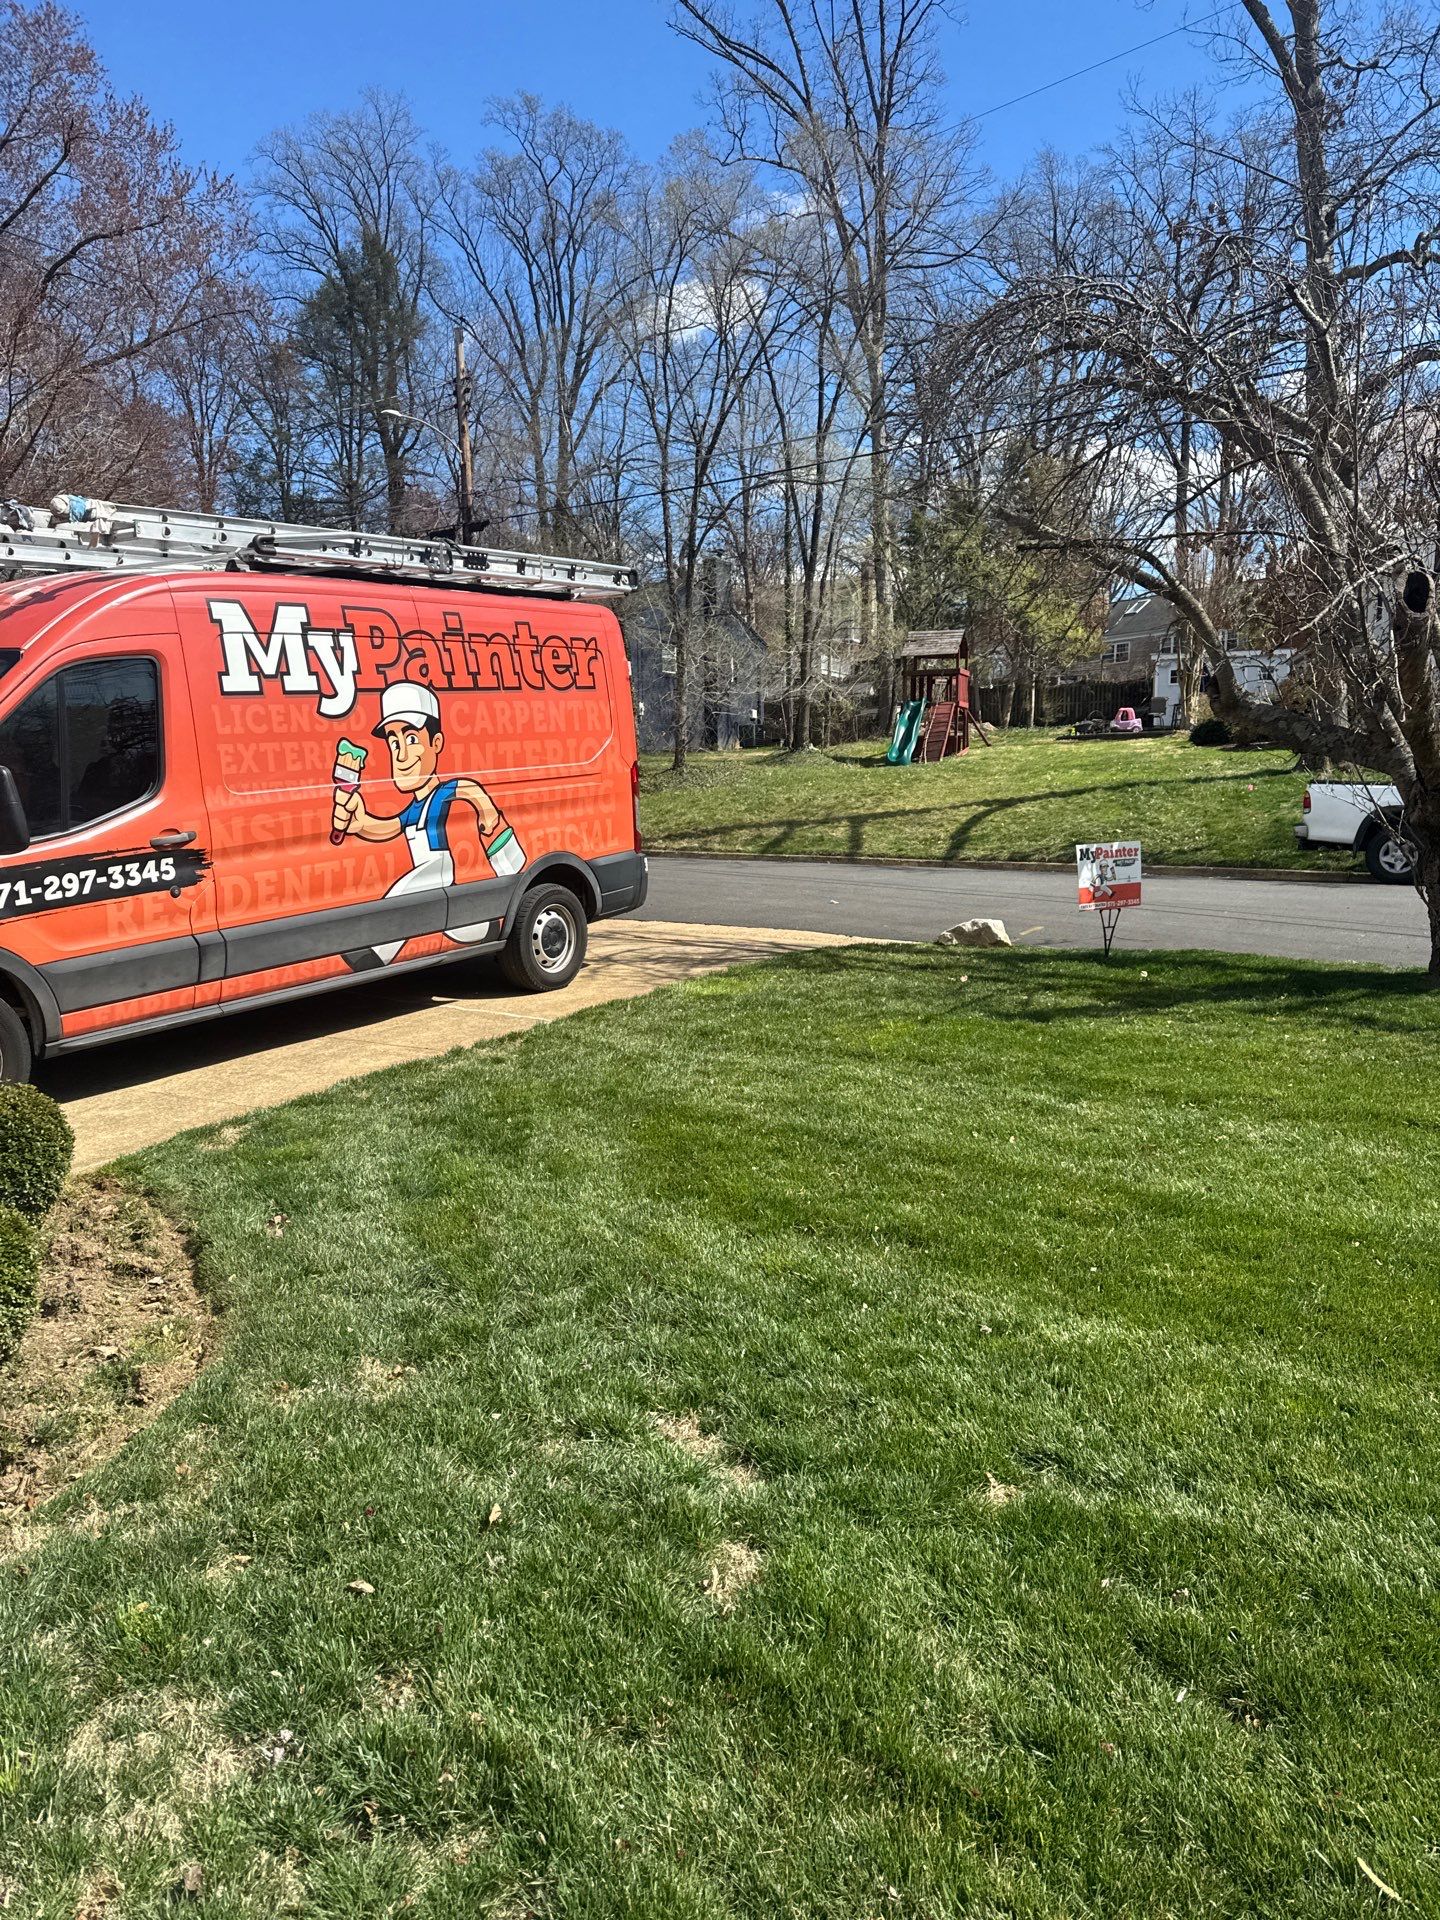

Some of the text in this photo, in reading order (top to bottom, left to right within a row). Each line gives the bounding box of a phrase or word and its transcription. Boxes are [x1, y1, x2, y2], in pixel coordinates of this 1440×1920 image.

[206, 598, 600, 717] MyPainter
[450, 699, 613, 736] CARPENTRY
[216, 738, 377, 776] EXTERIR
[451, 736, 626, 784] INTERIOR
[204, 772, 377, 808] MAINTENAE
[498, 780, 616, 823] ASHING
[452, 819, 619, 874] OERCIAL
[1079, 845, 1139, 863] MyPainter
